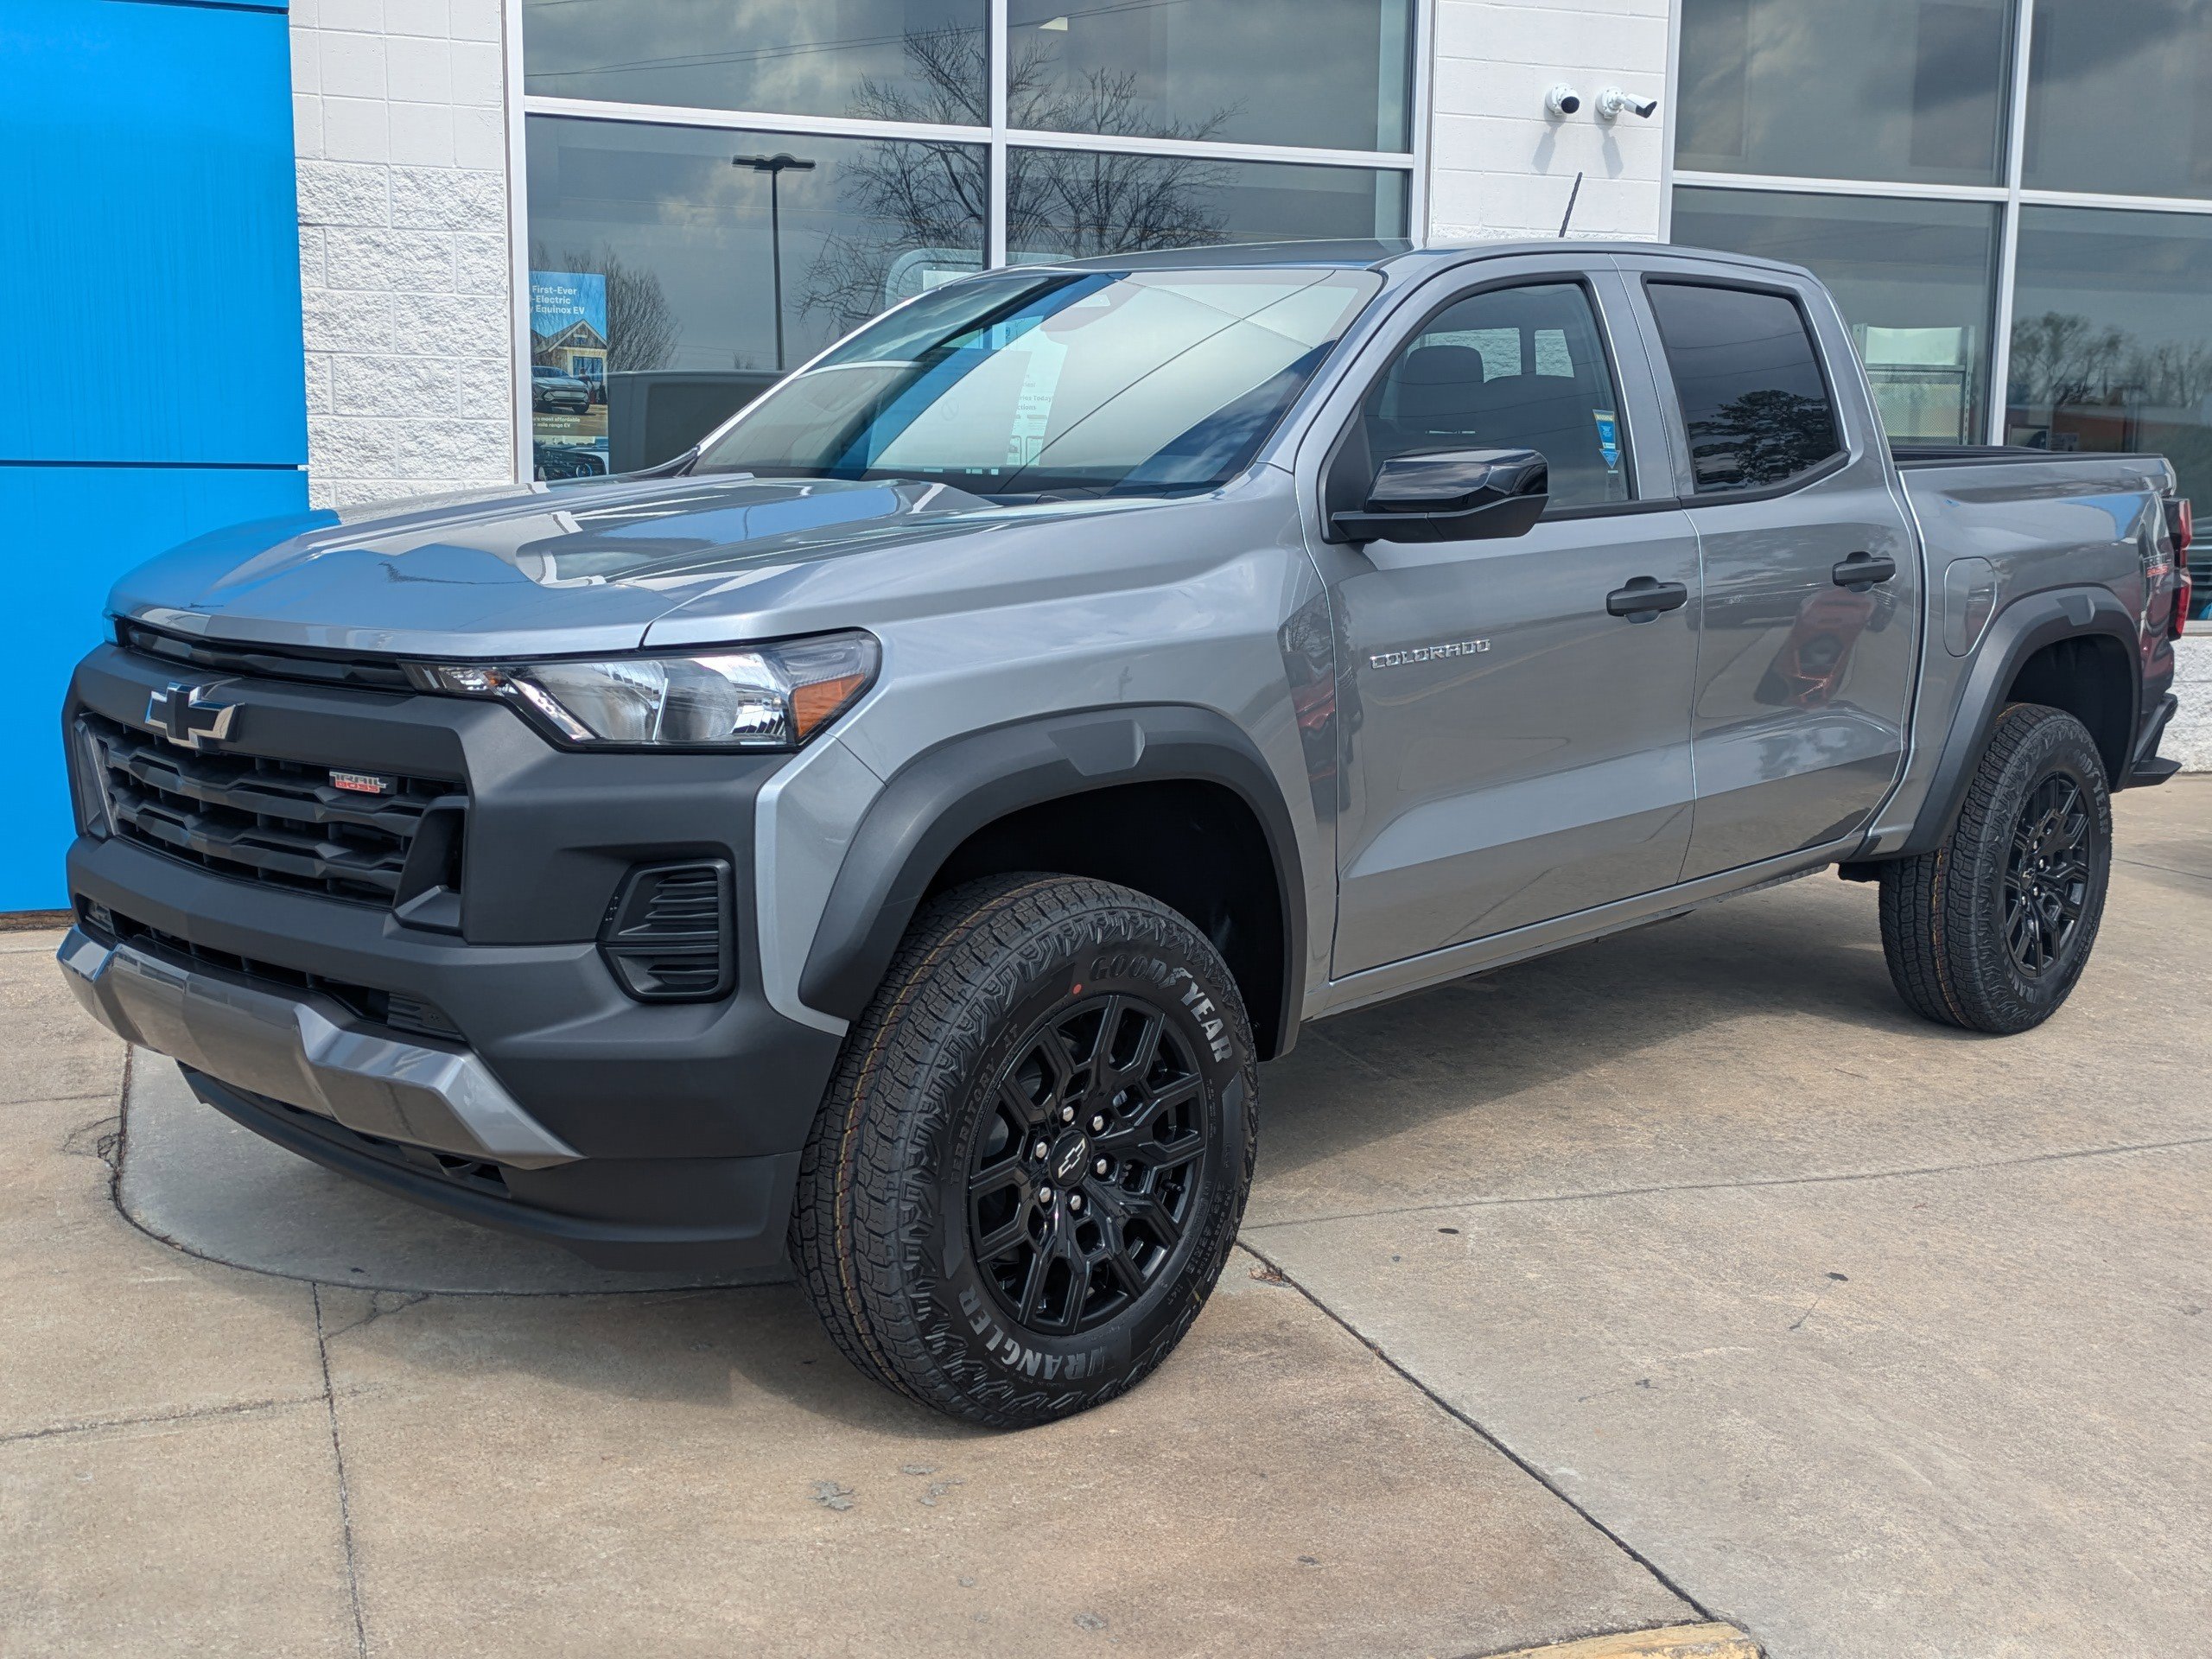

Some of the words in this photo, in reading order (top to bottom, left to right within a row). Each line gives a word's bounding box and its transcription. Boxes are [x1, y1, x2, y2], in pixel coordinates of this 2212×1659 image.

[531, 285, 577, 295] First-Ever
[535, 304, 571, 315] Equinox
[1369, 639, 1491, 671] COLORADO
[328, 771, 387, 789] TRAIL
[958, 1285, 1116, 1382] WRANGLER
